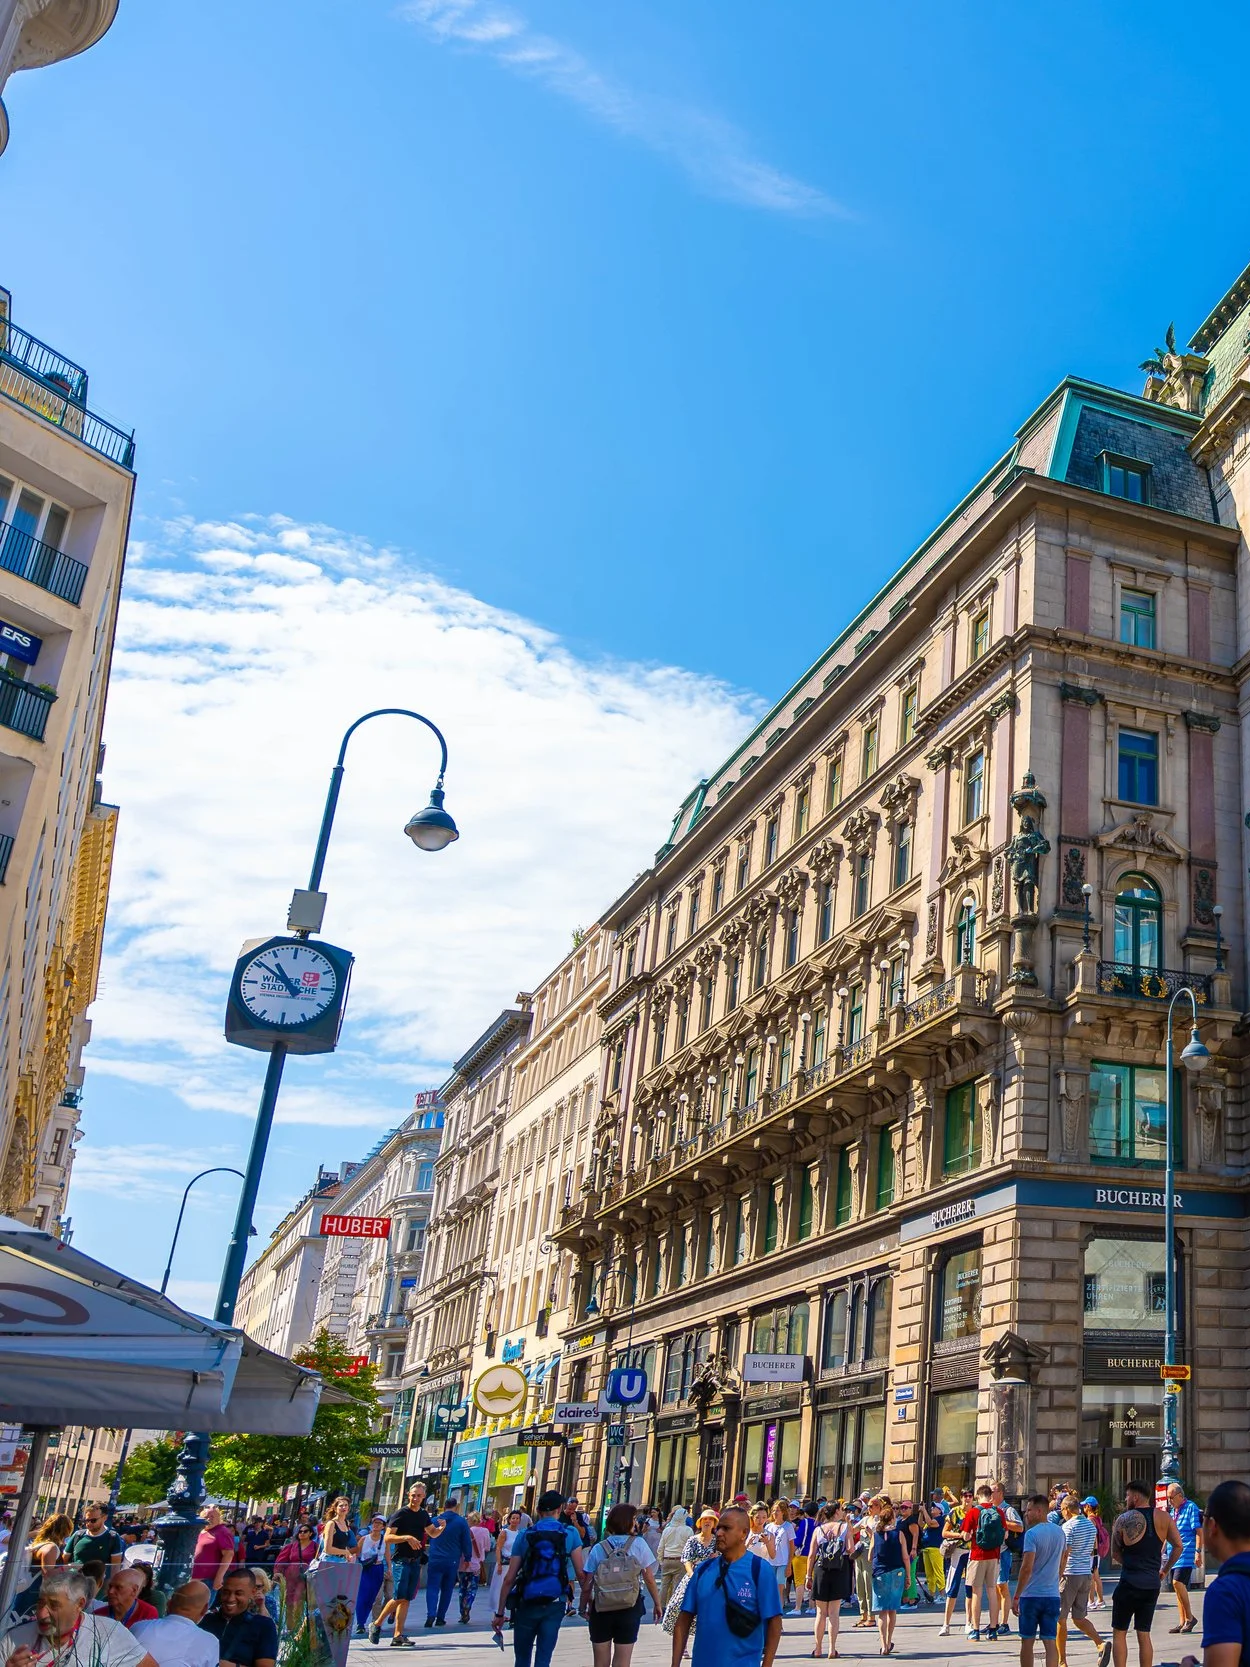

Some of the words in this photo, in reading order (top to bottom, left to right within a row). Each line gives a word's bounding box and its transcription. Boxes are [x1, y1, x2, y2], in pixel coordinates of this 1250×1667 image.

[2, 626, 32, 647] EFS
[931, 1199, 973, 1225] BUCHERER
[752, 1361, 796, 1369] BUCHERER
[1107, 1359, 1160, 1368] BUCHERER
[620, 1375, 643, 1398] U
[558, 1406, 600, 1418] claire's
[610, 1425, 625, 1436] WC
[1109, 1421, 1128, 1429] PATEK
[1129, 1421, 1155, 1429] PHILIPPE
[523, 1439, 557, 1447] wutscher
